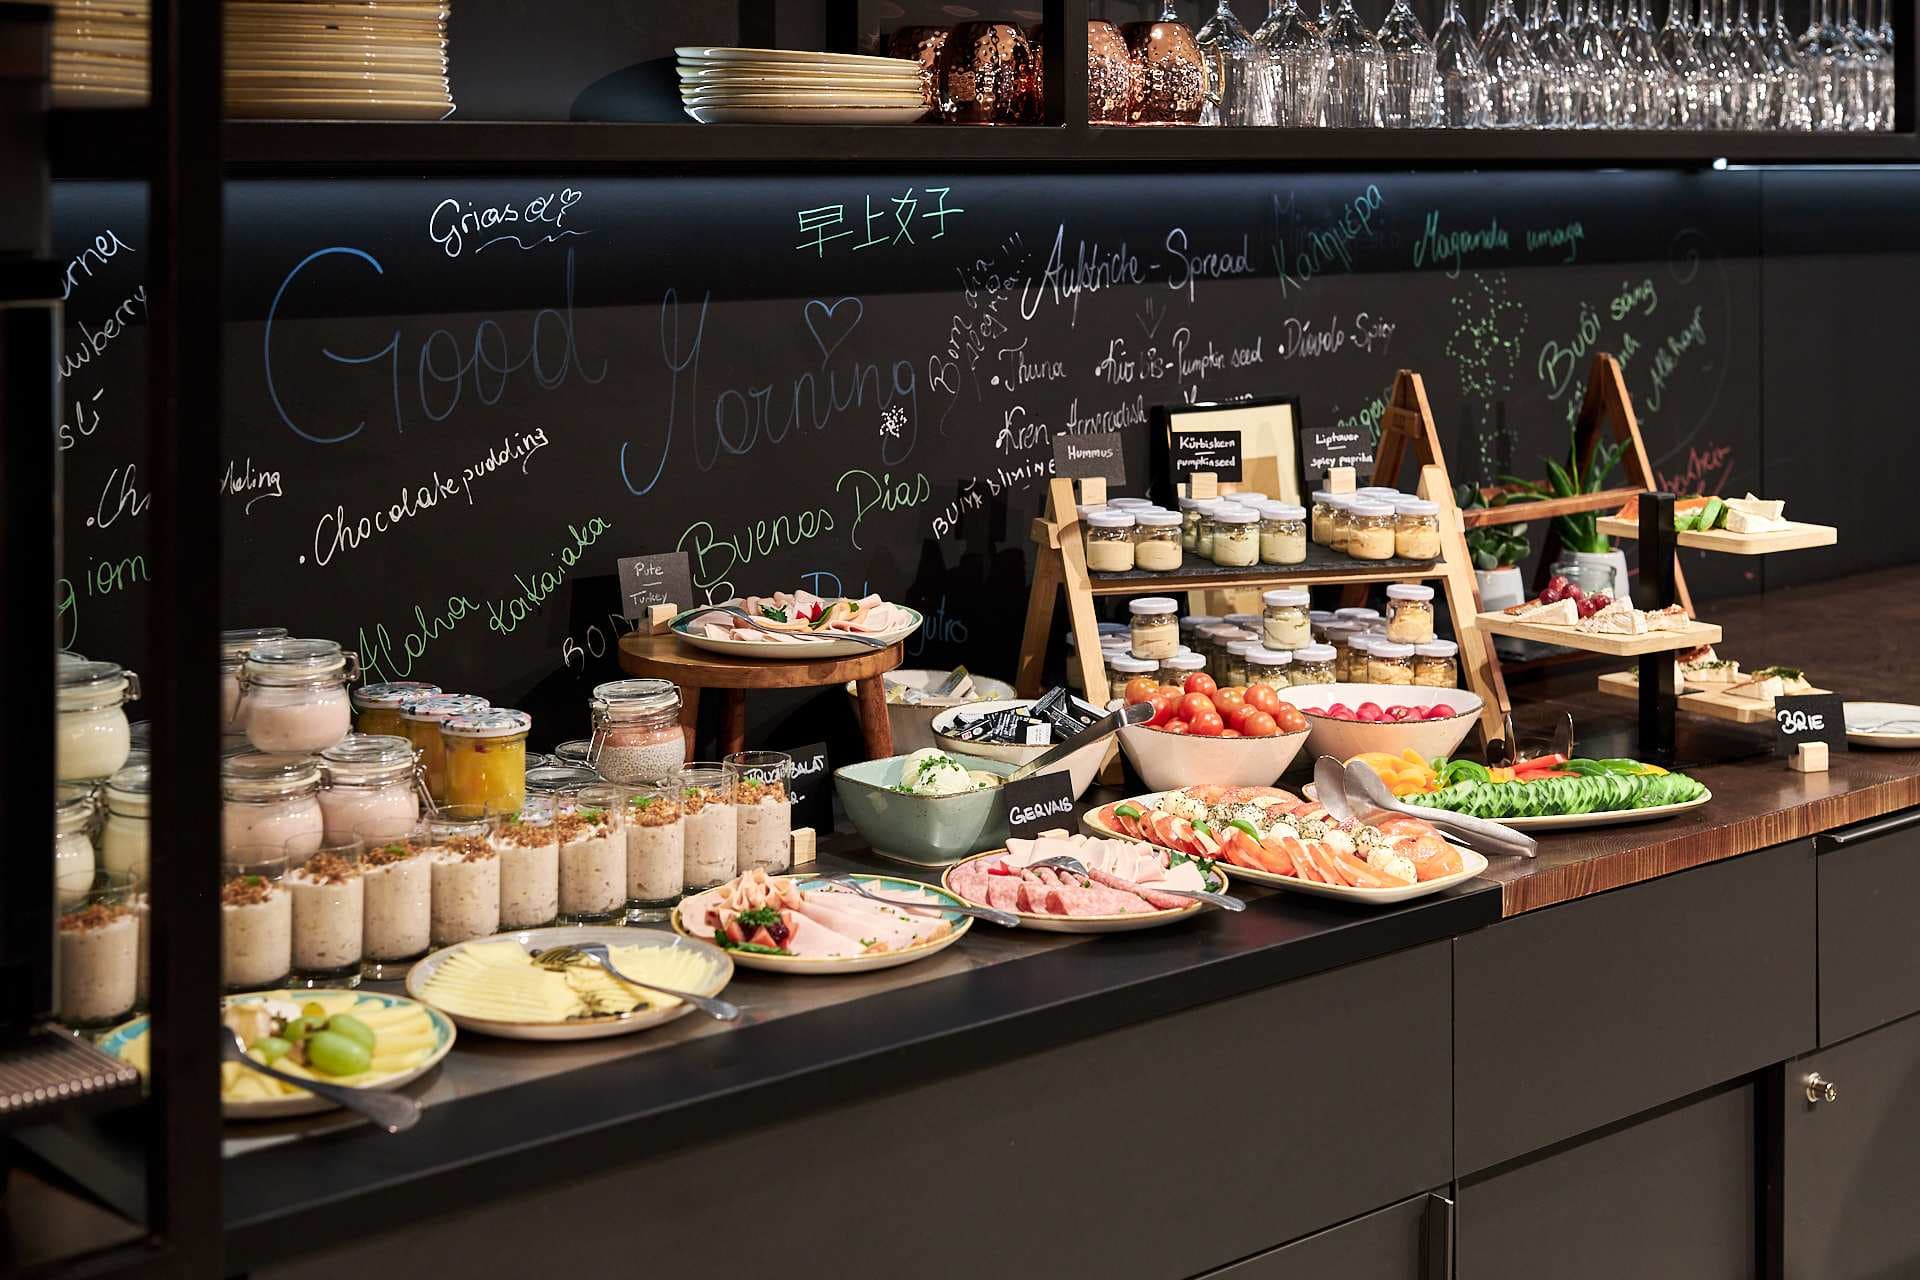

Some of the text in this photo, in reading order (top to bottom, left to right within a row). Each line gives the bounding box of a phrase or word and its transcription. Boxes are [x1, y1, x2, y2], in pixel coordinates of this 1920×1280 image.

[796, 187, 964, 258] 早上好
[1166, 227, 1255, 303] Spread
[1230, 336, 1264, 369] seed
[264, 246, 917, 496] Good Morning
[999, 405, 1050, 455] Kren
[1179, 436, 1236, 450] Kürbiskern
[1067, 445, 1115, 460] Hummus
[633, 561, 664, 577] Pute
[676, 521, 835, 589] Buenos
[629, 590, 668, 605] Turkey
[358, 596, 481, 686] Aloha
[1776, 709, 1825, 735] BRIE
[1009, 796, 1073, 825] GERVAIS
